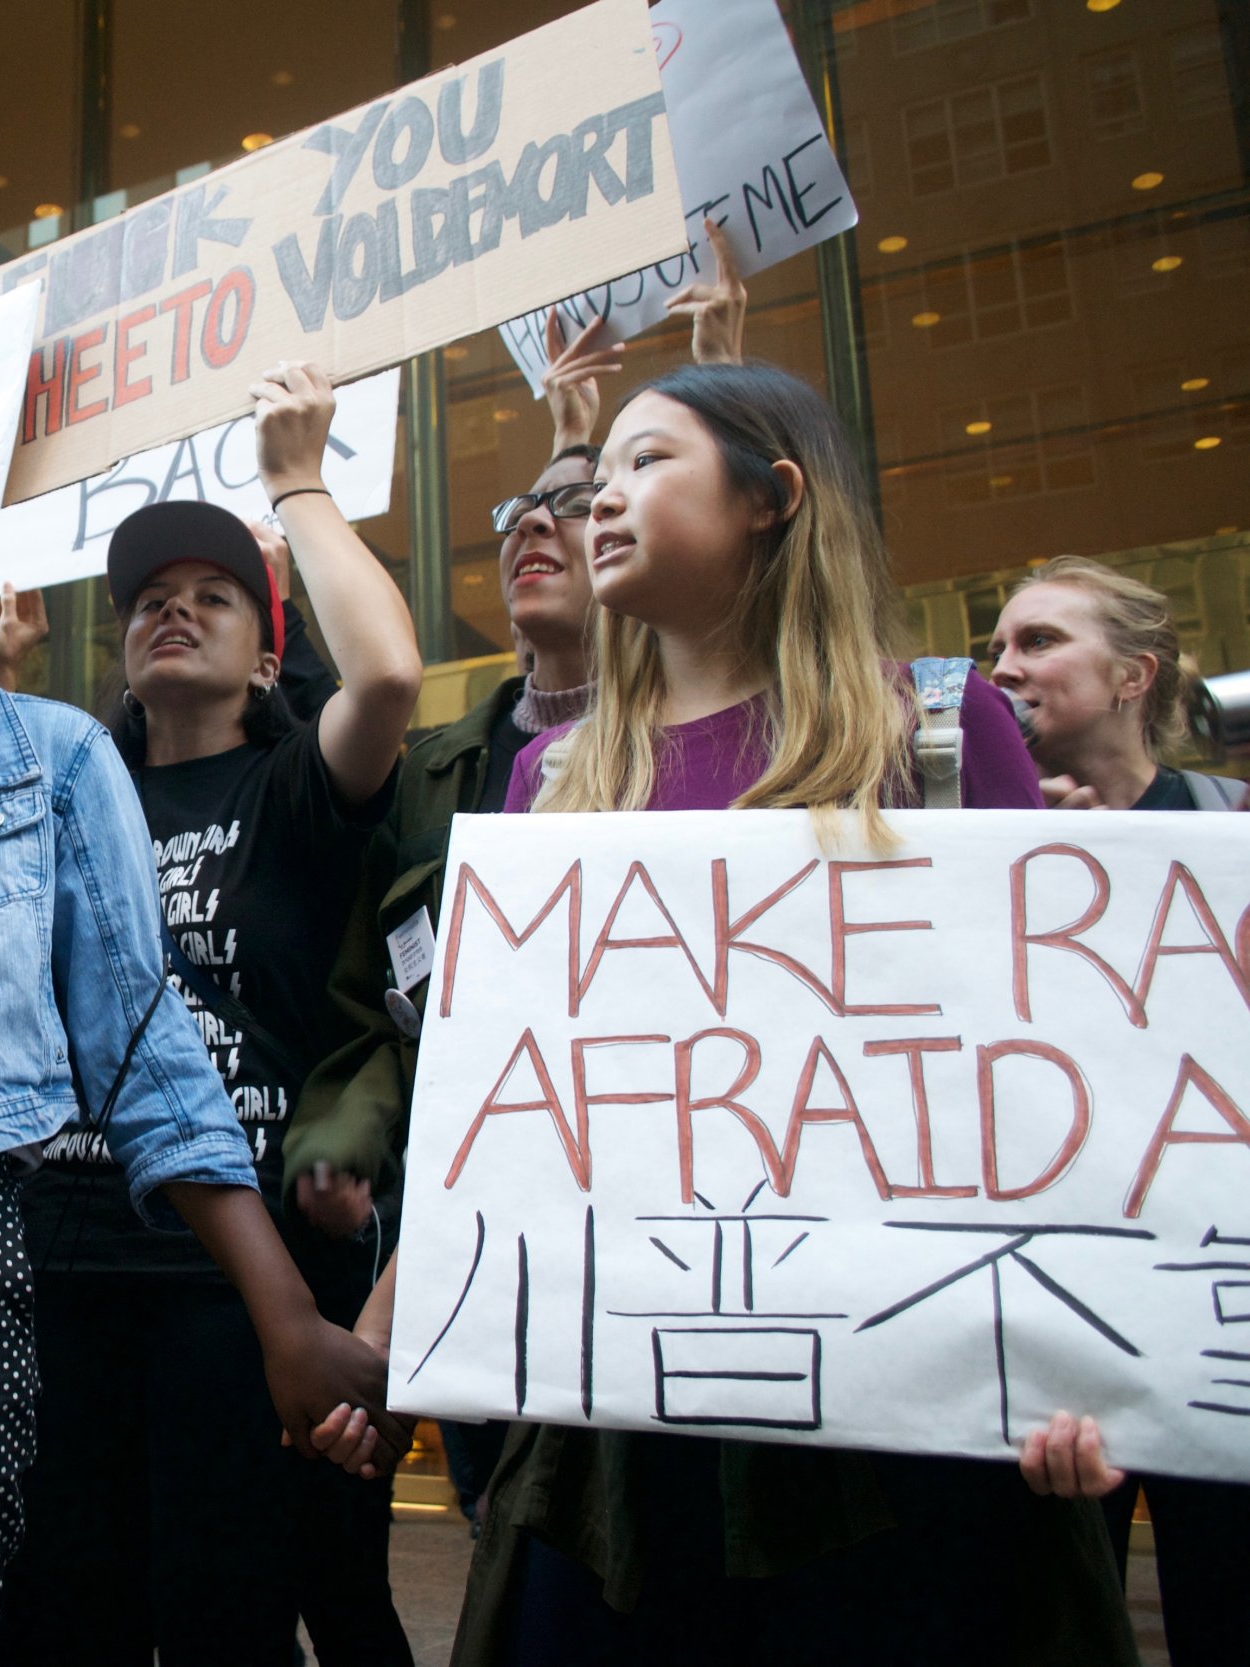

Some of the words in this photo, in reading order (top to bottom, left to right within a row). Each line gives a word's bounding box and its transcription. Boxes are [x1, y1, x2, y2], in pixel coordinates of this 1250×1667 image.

[271, 91, 667, 333] VOLDEMORT
[302, 57, 505, 216] YOU
[743, 133, 843, 253] ME
[440, 857, 944, 1021] MAKE
[1010, 843, 1250, 1030] RA
[444, 1027, 1094, 1204] AFRAID
